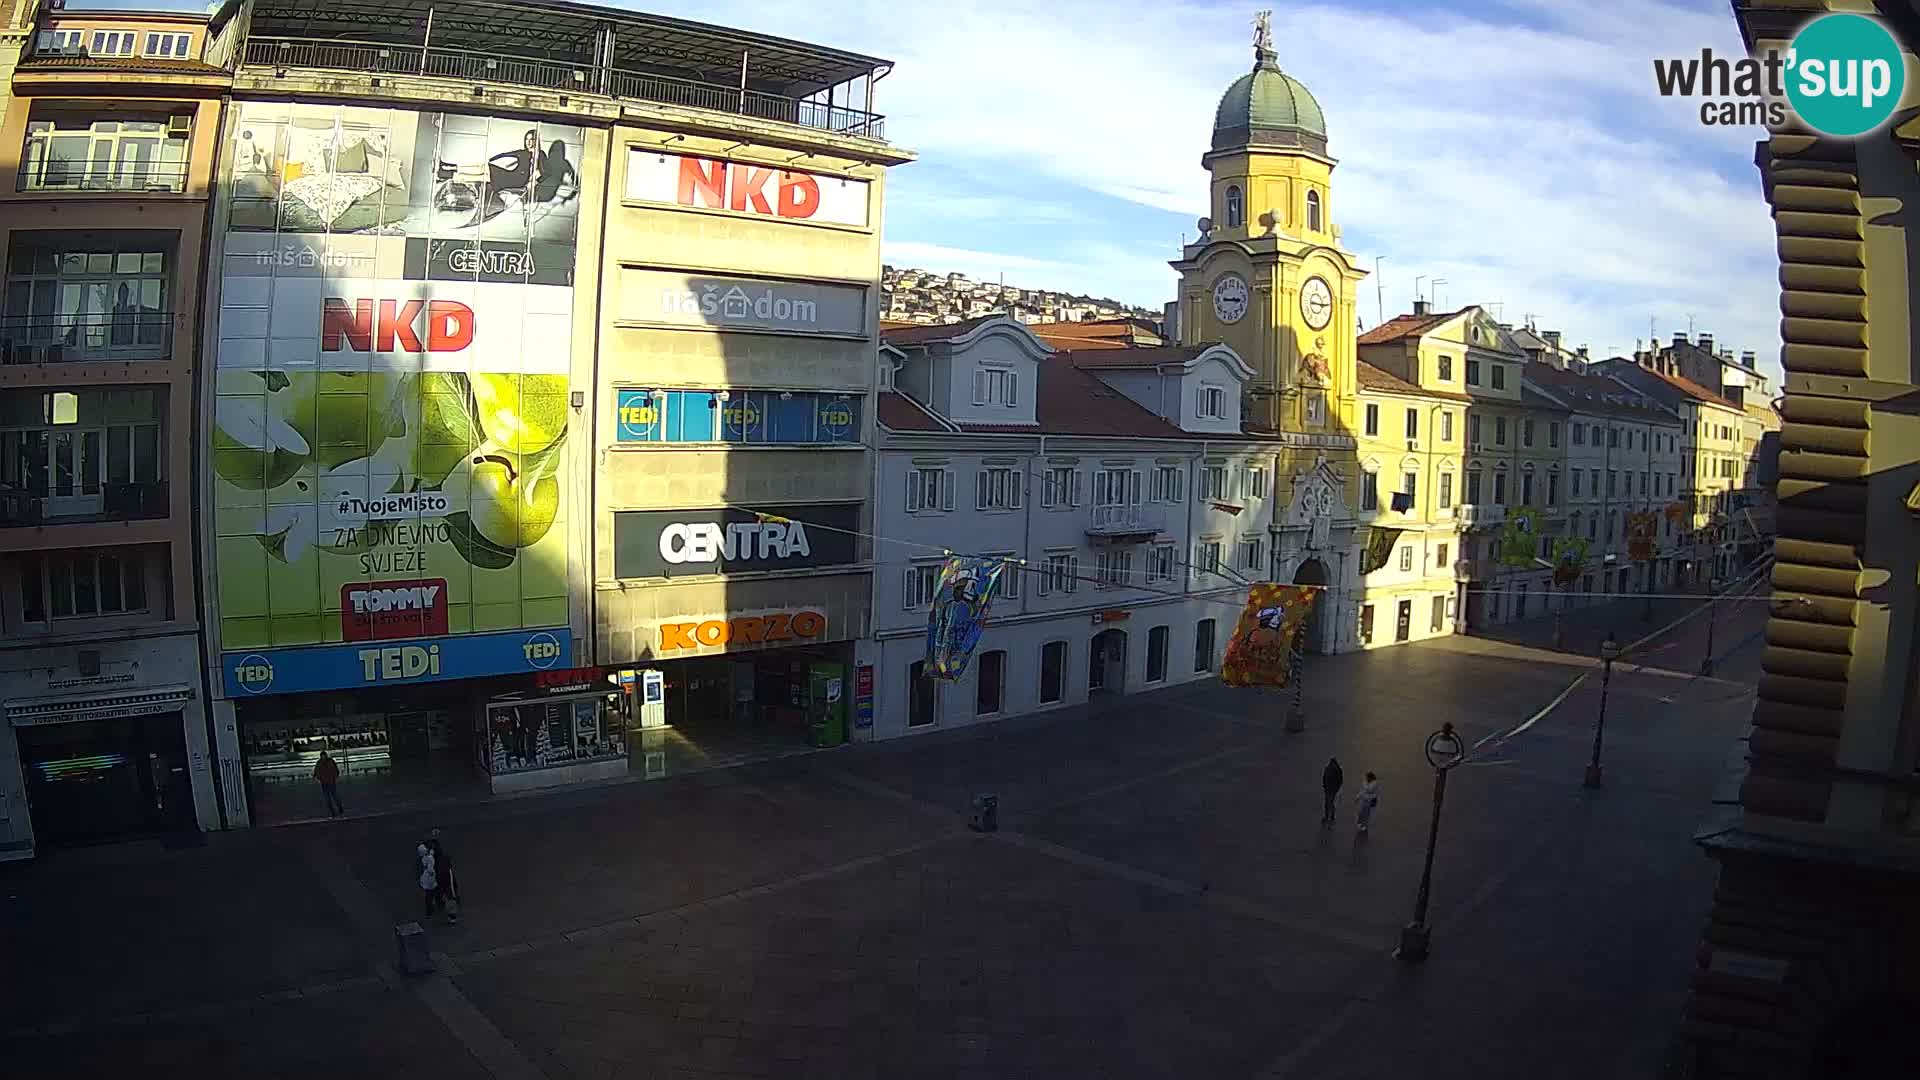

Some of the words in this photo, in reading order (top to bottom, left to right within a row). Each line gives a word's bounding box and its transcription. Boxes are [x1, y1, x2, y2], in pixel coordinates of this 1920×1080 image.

[677, 156, 820, 218] NKD
[449, 249, 535, 275] CENTRA
[661, 284, 718, 315] naš
[754, 289, 816, 322] dom
[321, 297, 475, 352] NKD
[619, 407, 658, 424] TEDi
[724, 408, 759, 425] TEDi
[821, 411, 853, 425] TEDi
[339, 496, 447, 515] #TvojeMisto
[334, 528, 359, 548] ZA
[367, 523, 450, 547] DNEVNO
[659, 520, 811, 564] CENTRA
[360, 547, 427, 574] SVJEŽE
[350, 585, 440, 613] TOMMY
[660, 611, 826, 650] KORZO
[523, 639, 560, 660] TEDi
[235, 665, 273, 683] TEDi
[360, 645, 440, 681] TEDi
